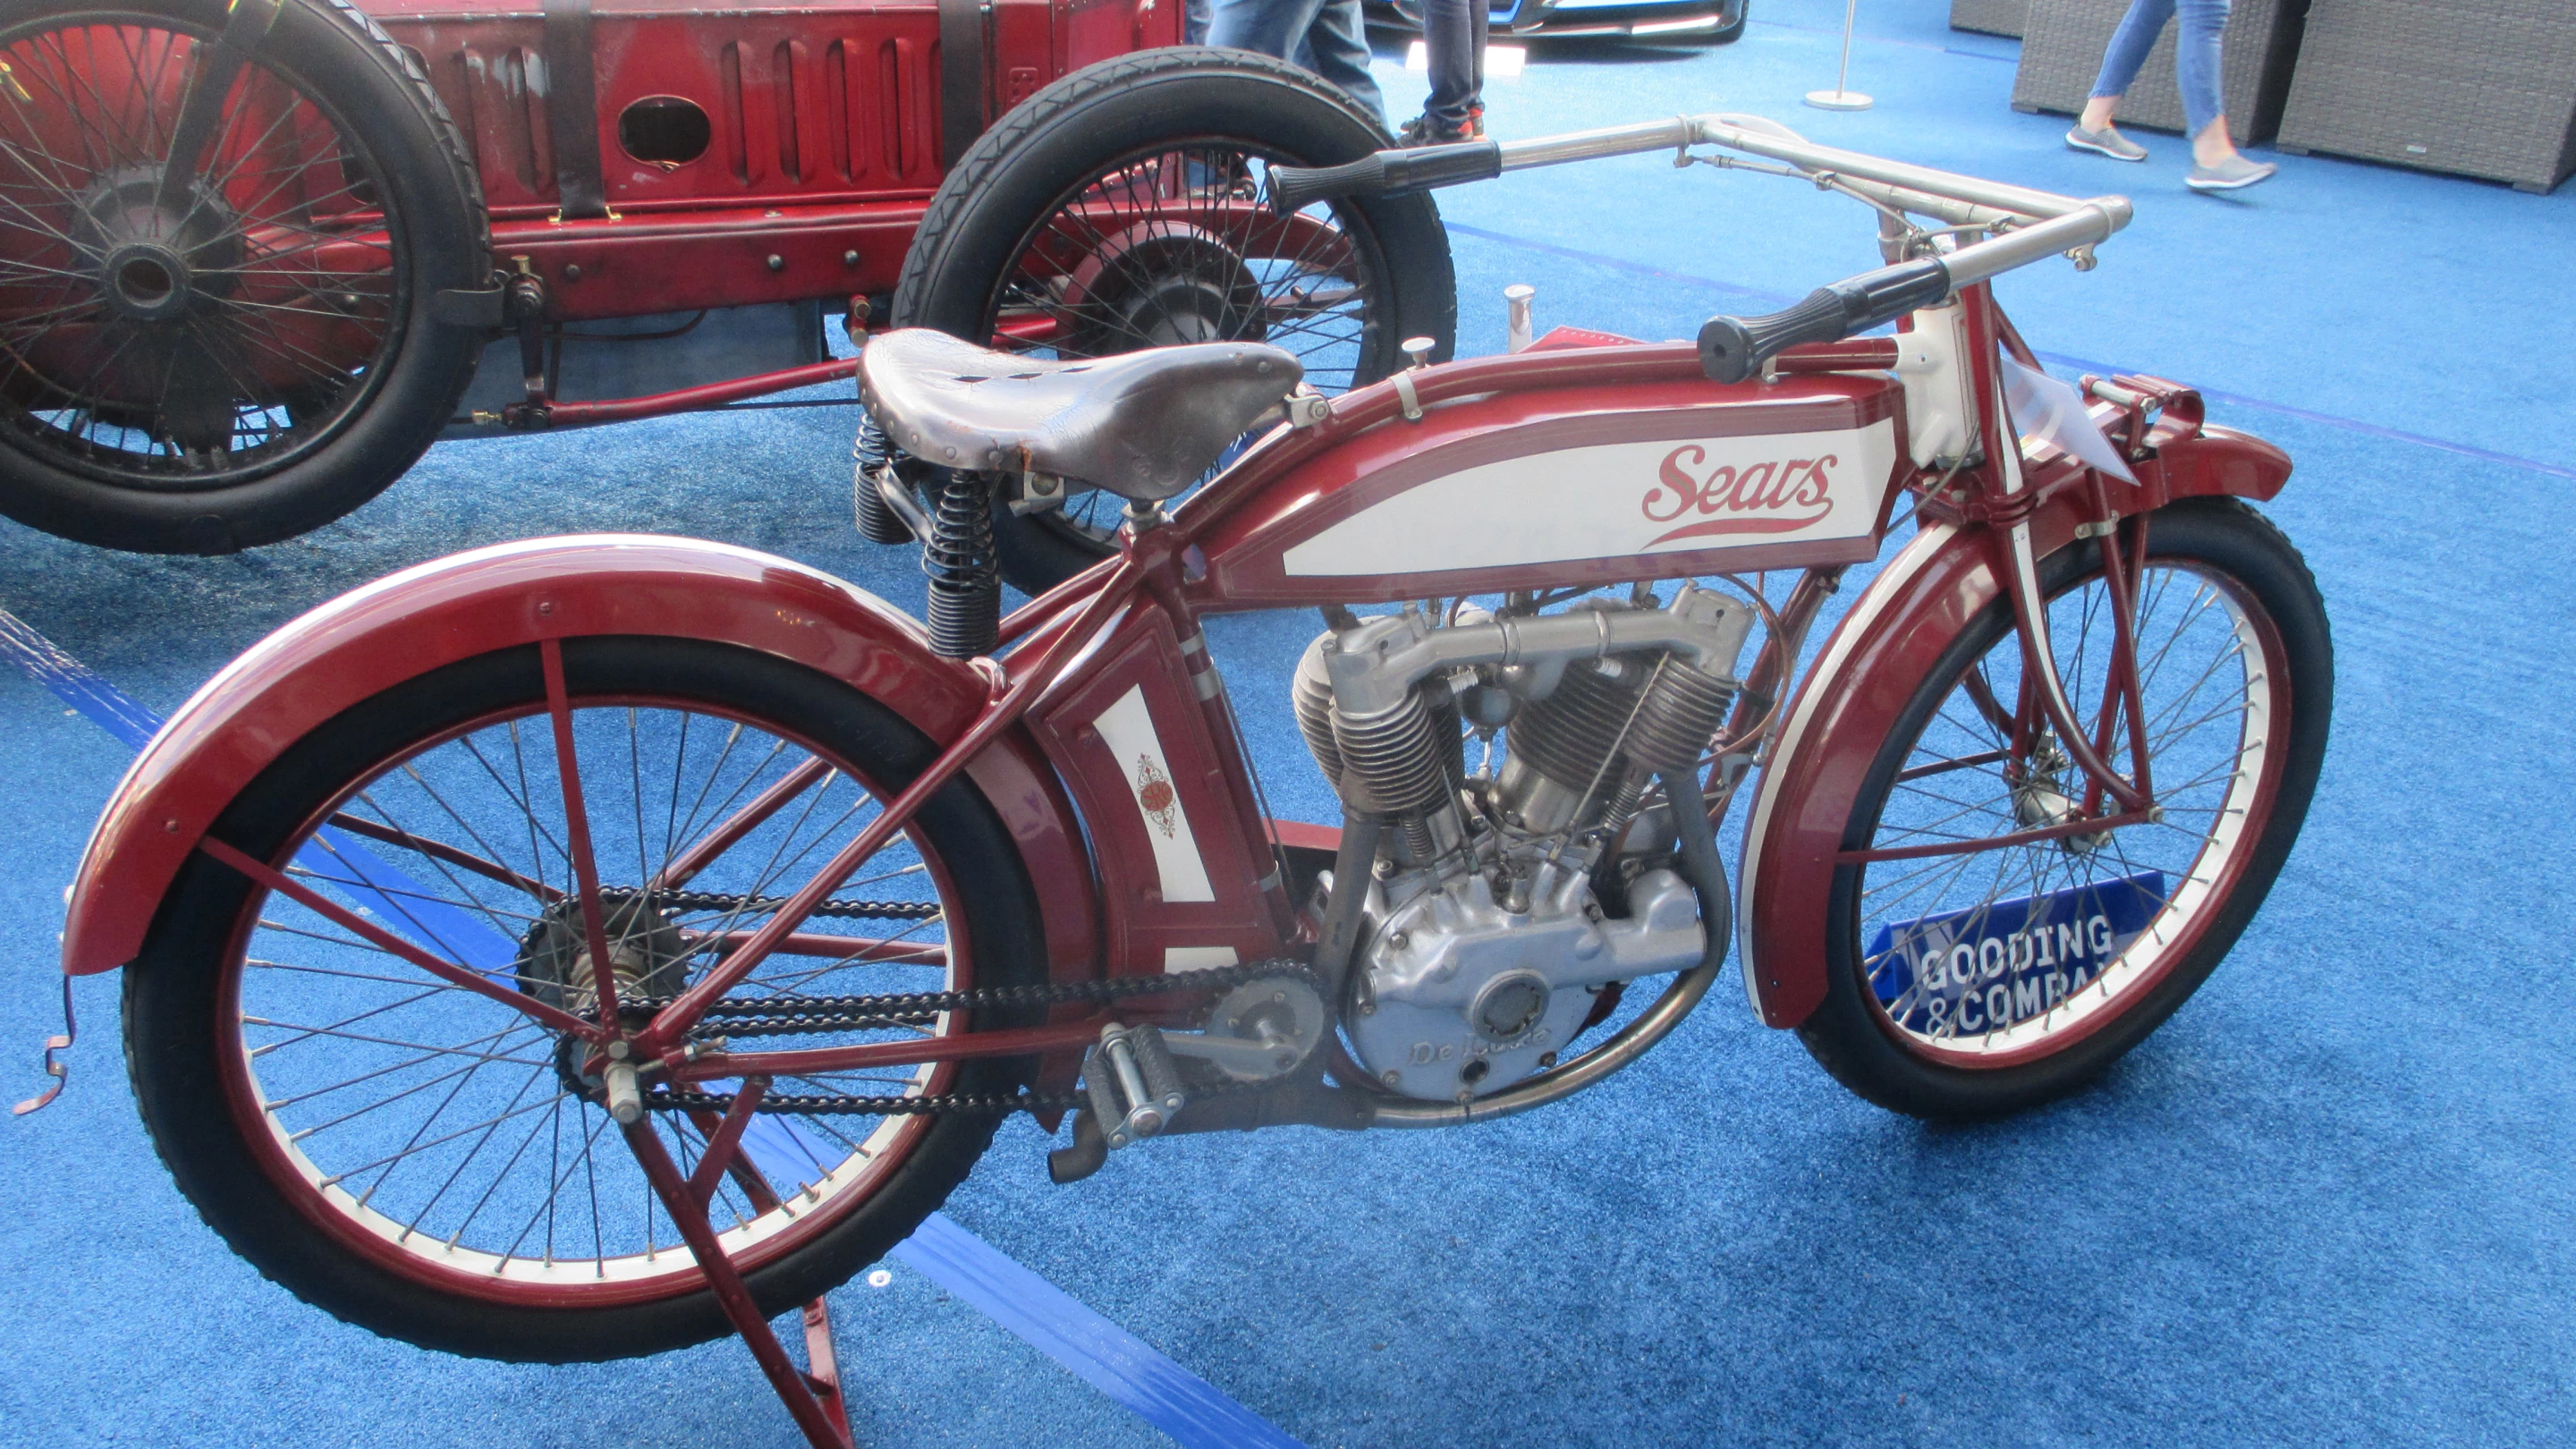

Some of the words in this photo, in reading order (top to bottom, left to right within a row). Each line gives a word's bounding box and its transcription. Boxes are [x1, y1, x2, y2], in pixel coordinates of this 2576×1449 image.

[1641, 445, 1838, 535] Sears
[1921, 915, 2112, 991] GOODING
[1409, 1040, 1453, 1065] De
